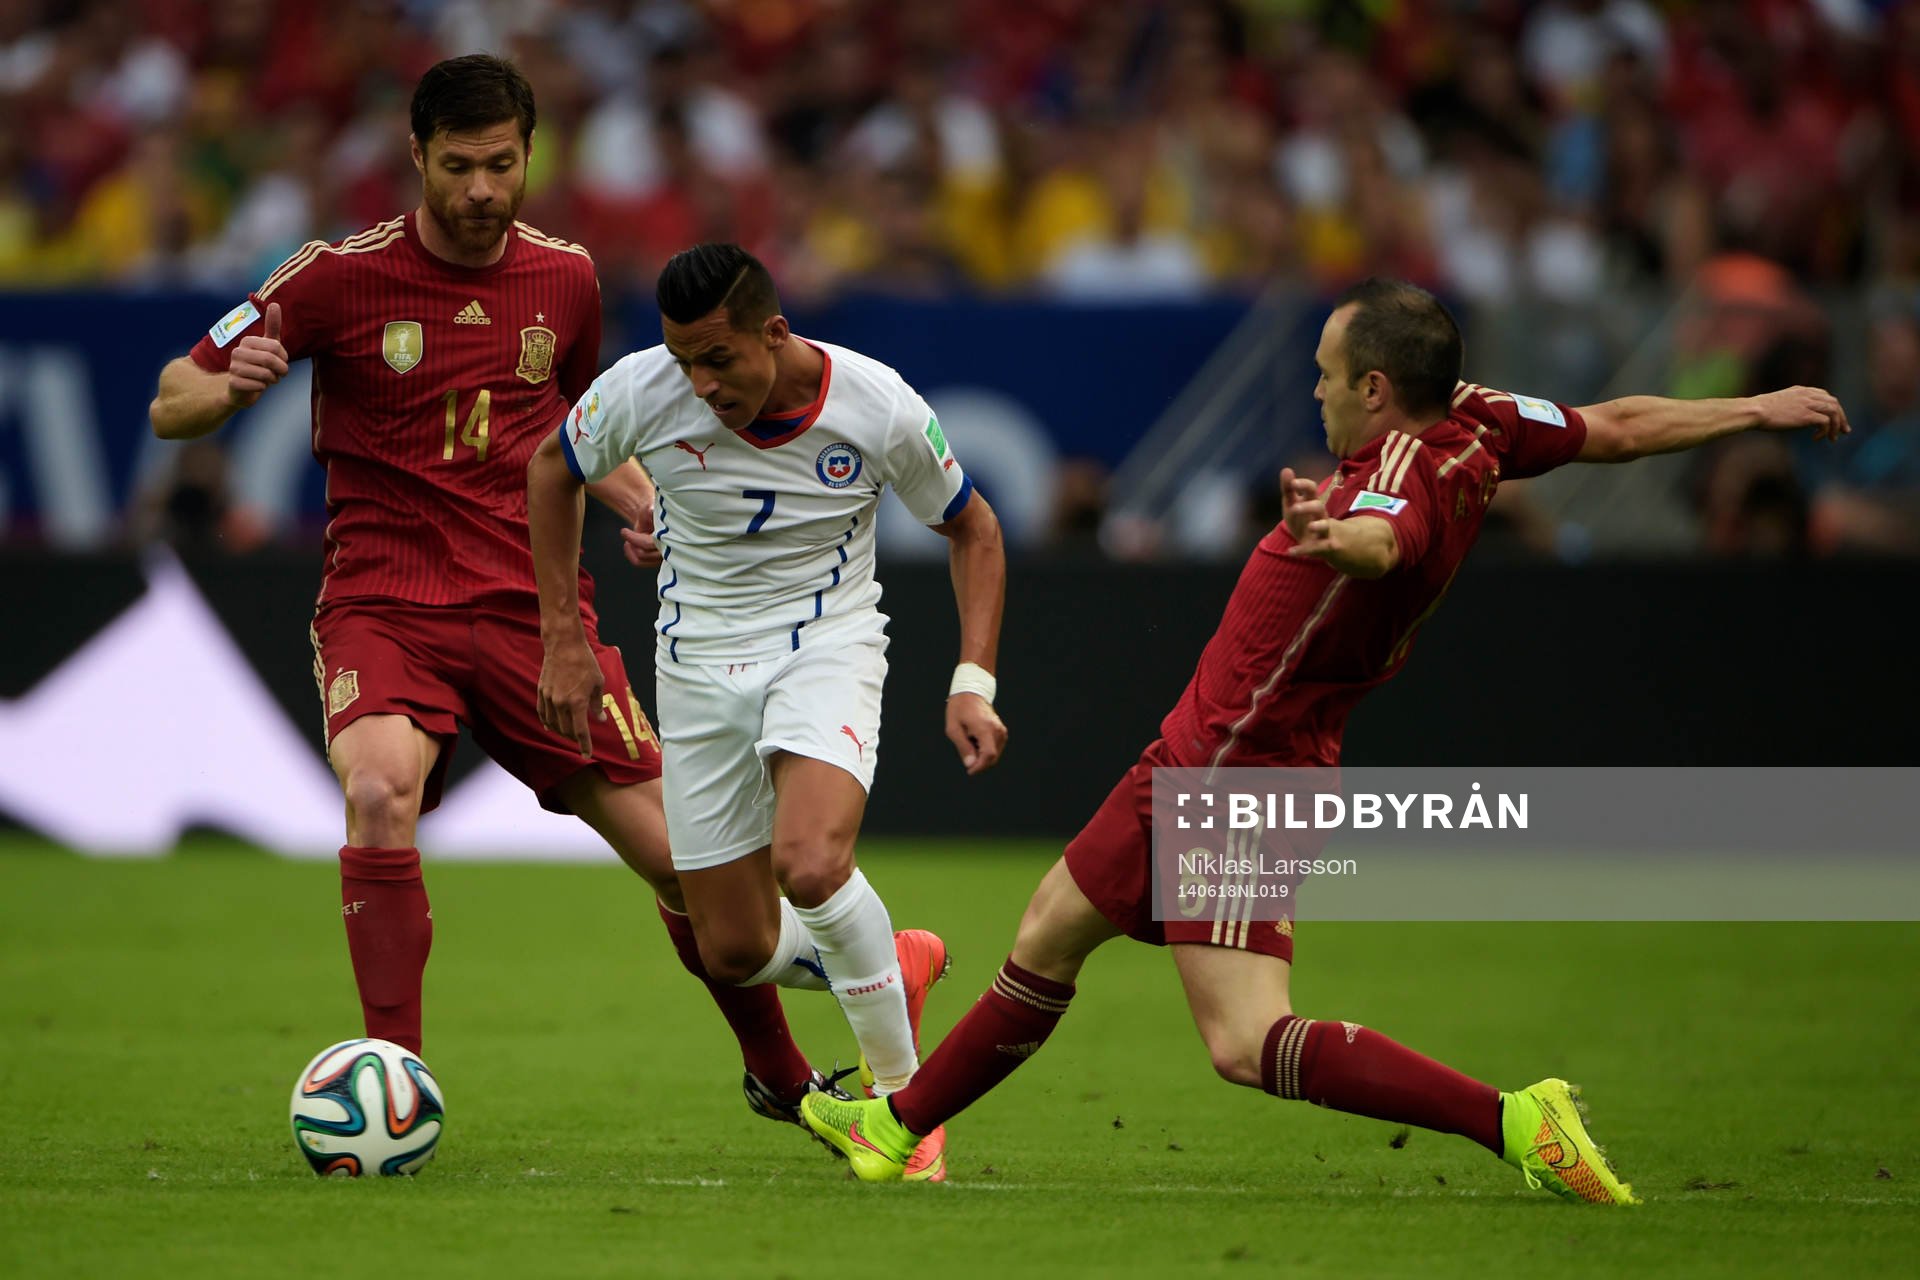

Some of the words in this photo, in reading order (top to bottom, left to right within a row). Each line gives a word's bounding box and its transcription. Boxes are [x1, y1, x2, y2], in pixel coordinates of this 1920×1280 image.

[453, 314, 491, 325] adidas
[440, 389, 491, 462] 14
[742, 489, 776, 534] 7
[602, 686, 660, 760] 14
